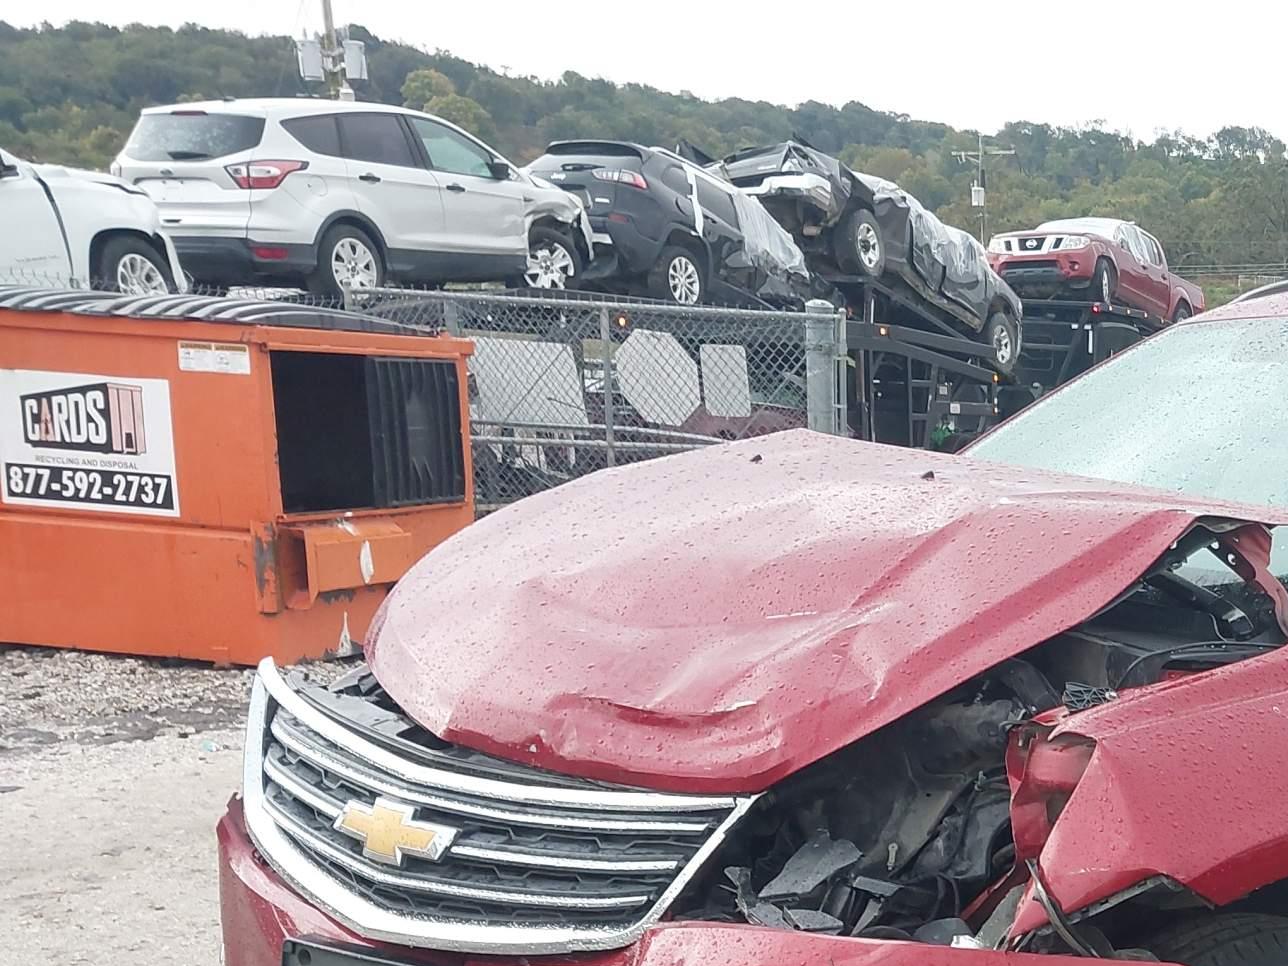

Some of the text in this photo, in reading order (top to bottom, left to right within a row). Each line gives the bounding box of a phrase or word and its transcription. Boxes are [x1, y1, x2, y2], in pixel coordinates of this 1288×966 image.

[24, 390, 108, 445] CARDS
[35, 455, 139, 471] RECYCLING AND DISPOSAL
[9, 466, 168, 505] 877-592-2737
